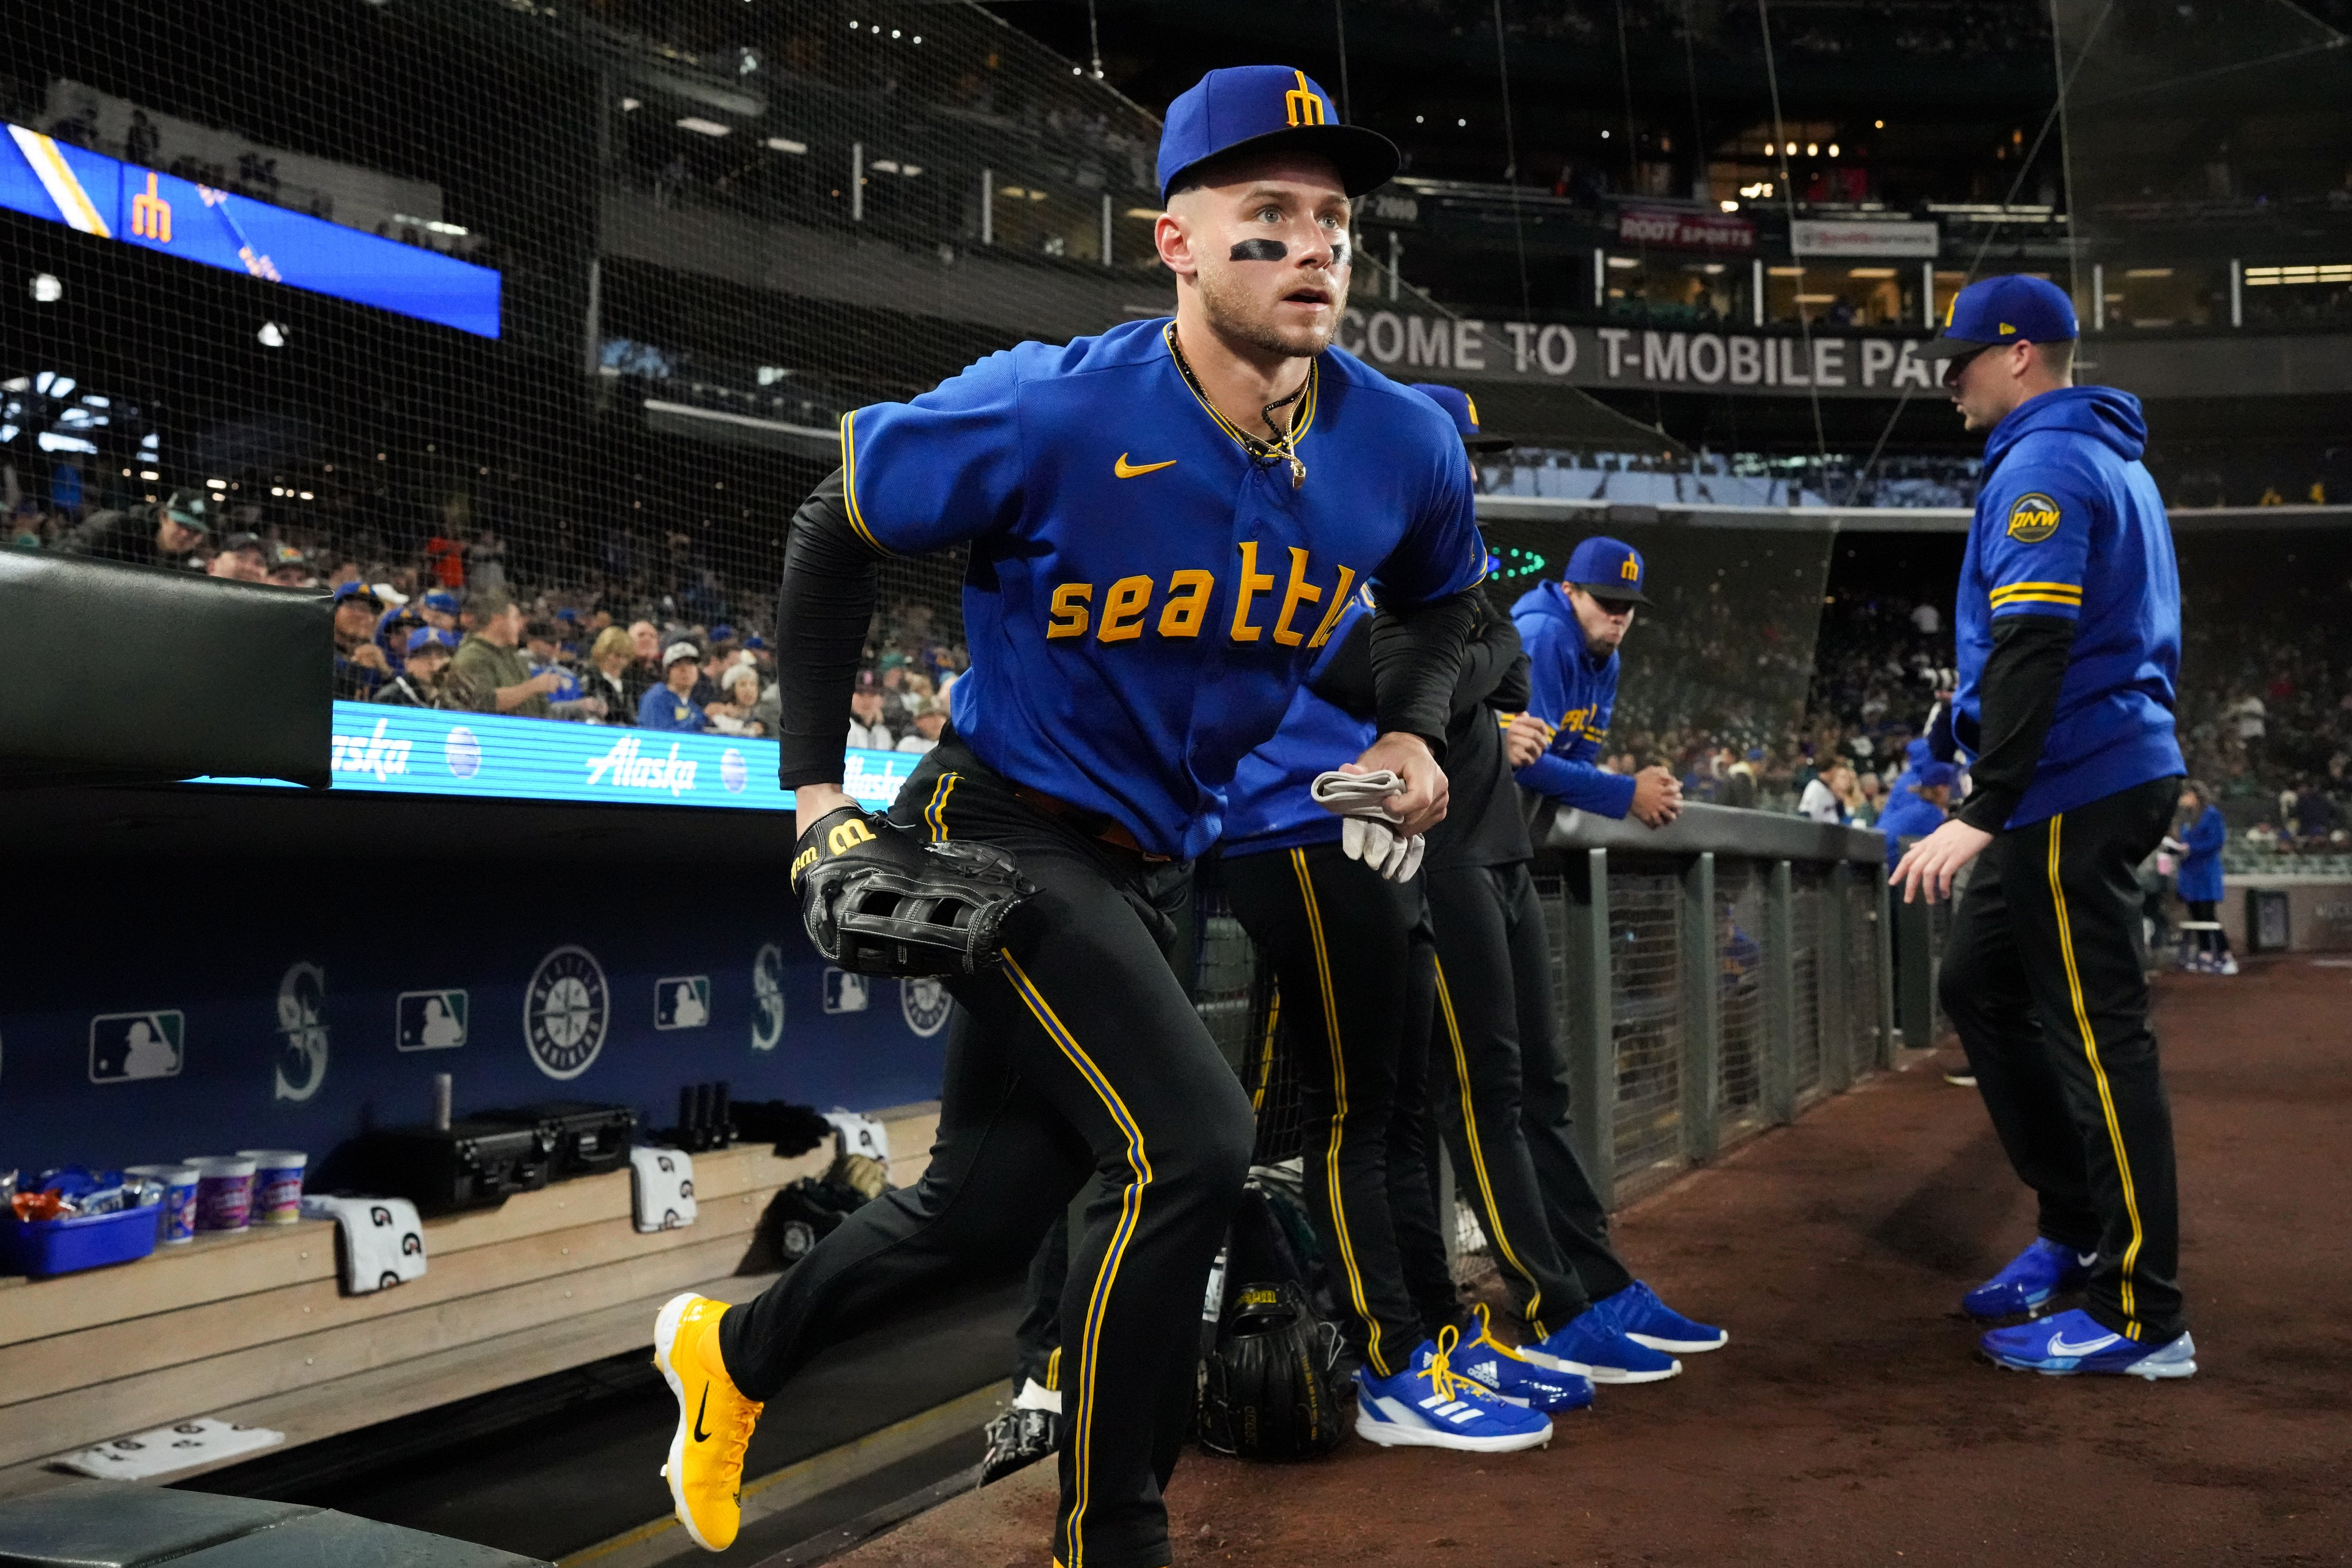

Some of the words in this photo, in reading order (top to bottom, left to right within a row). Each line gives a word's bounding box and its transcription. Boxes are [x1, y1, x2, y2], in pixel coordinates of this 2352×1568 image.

[1620, 218, 1680, 240] ROOT
[1681, 224, 1753, 246] SPORTS
[1504, 322, 1577, 375] TO
[1598, 328, 1846, 386] T-MOBILE
[585, 734, 698, 797] Alaska
